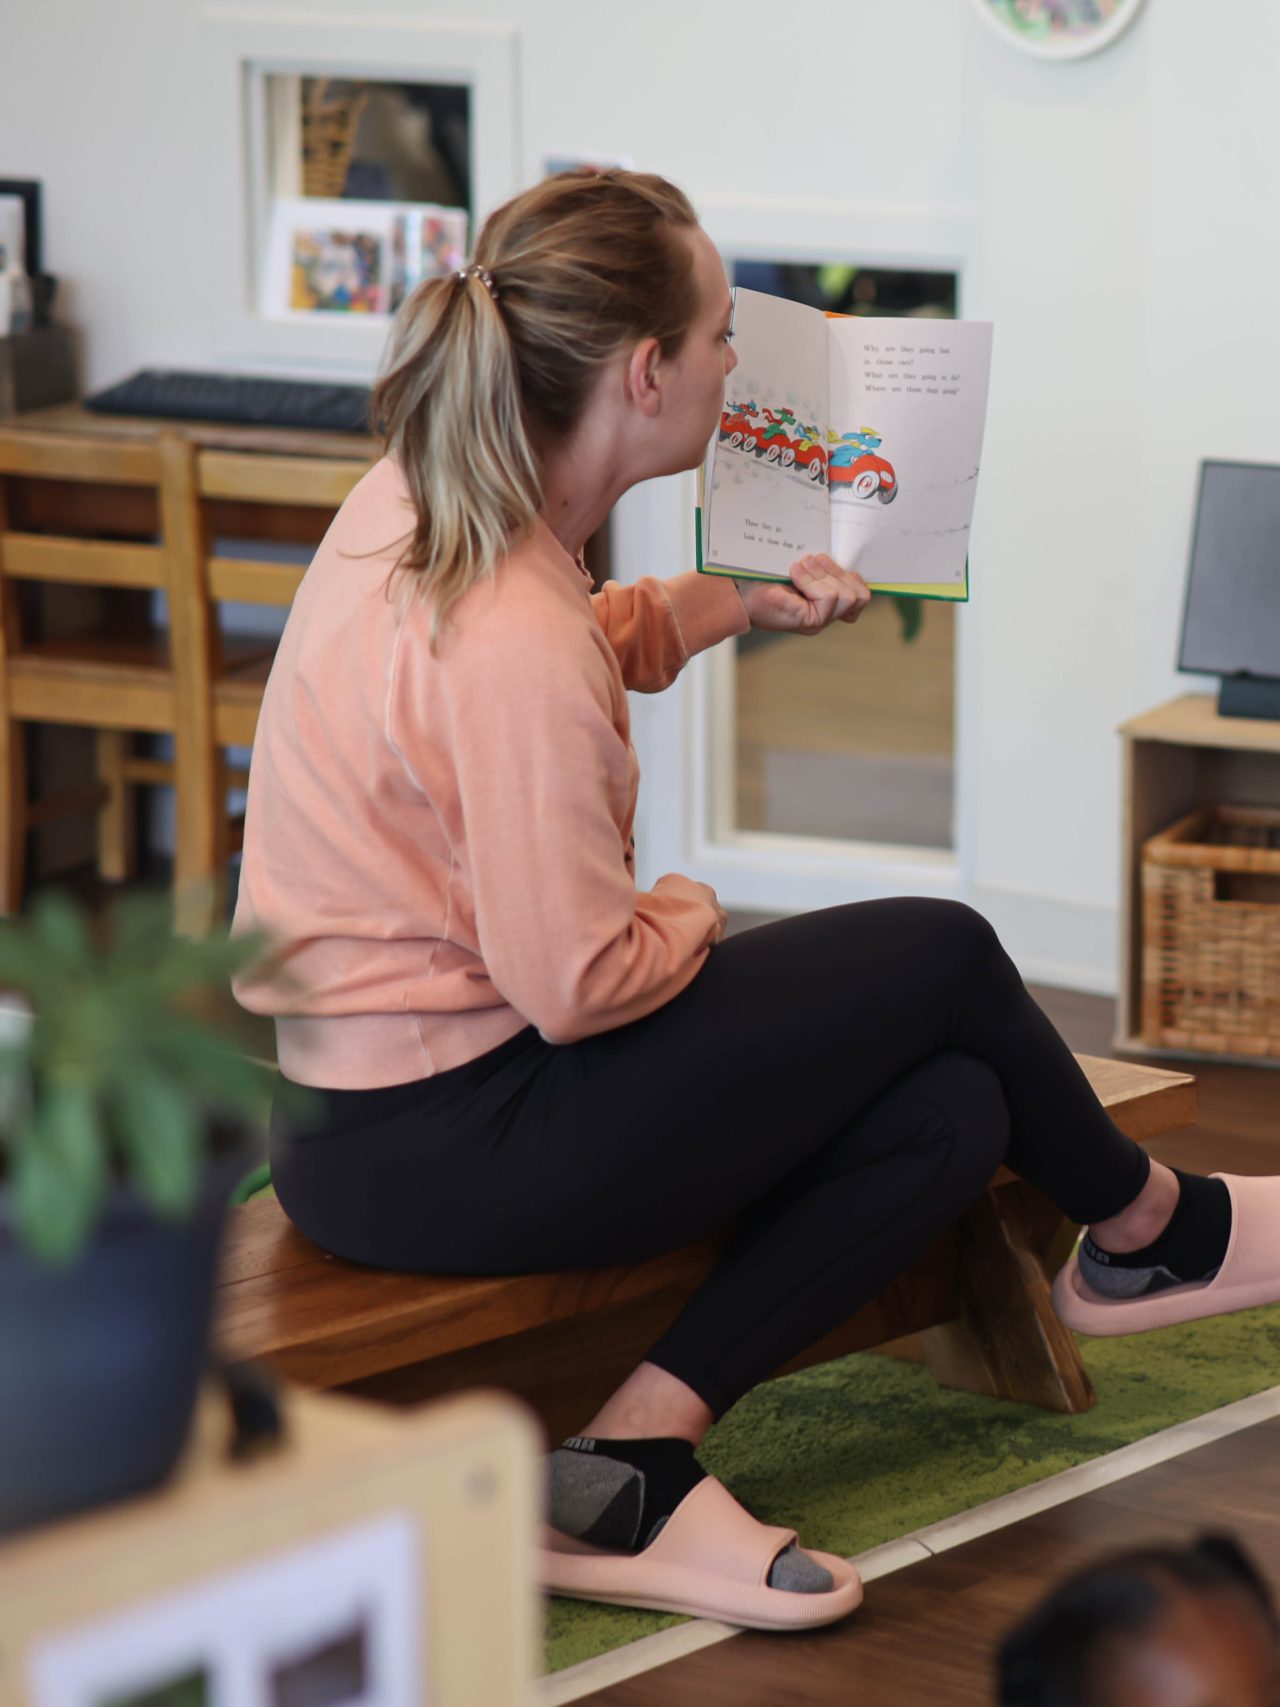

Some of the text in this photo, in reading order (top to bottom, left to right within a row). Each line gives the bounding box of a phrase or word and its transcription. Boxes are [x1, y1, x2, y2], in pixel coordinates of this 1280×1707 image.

[863, 344, 879, 353] Why
[919, 347, 935, 355] going
[864, 371, 883, 379] What
